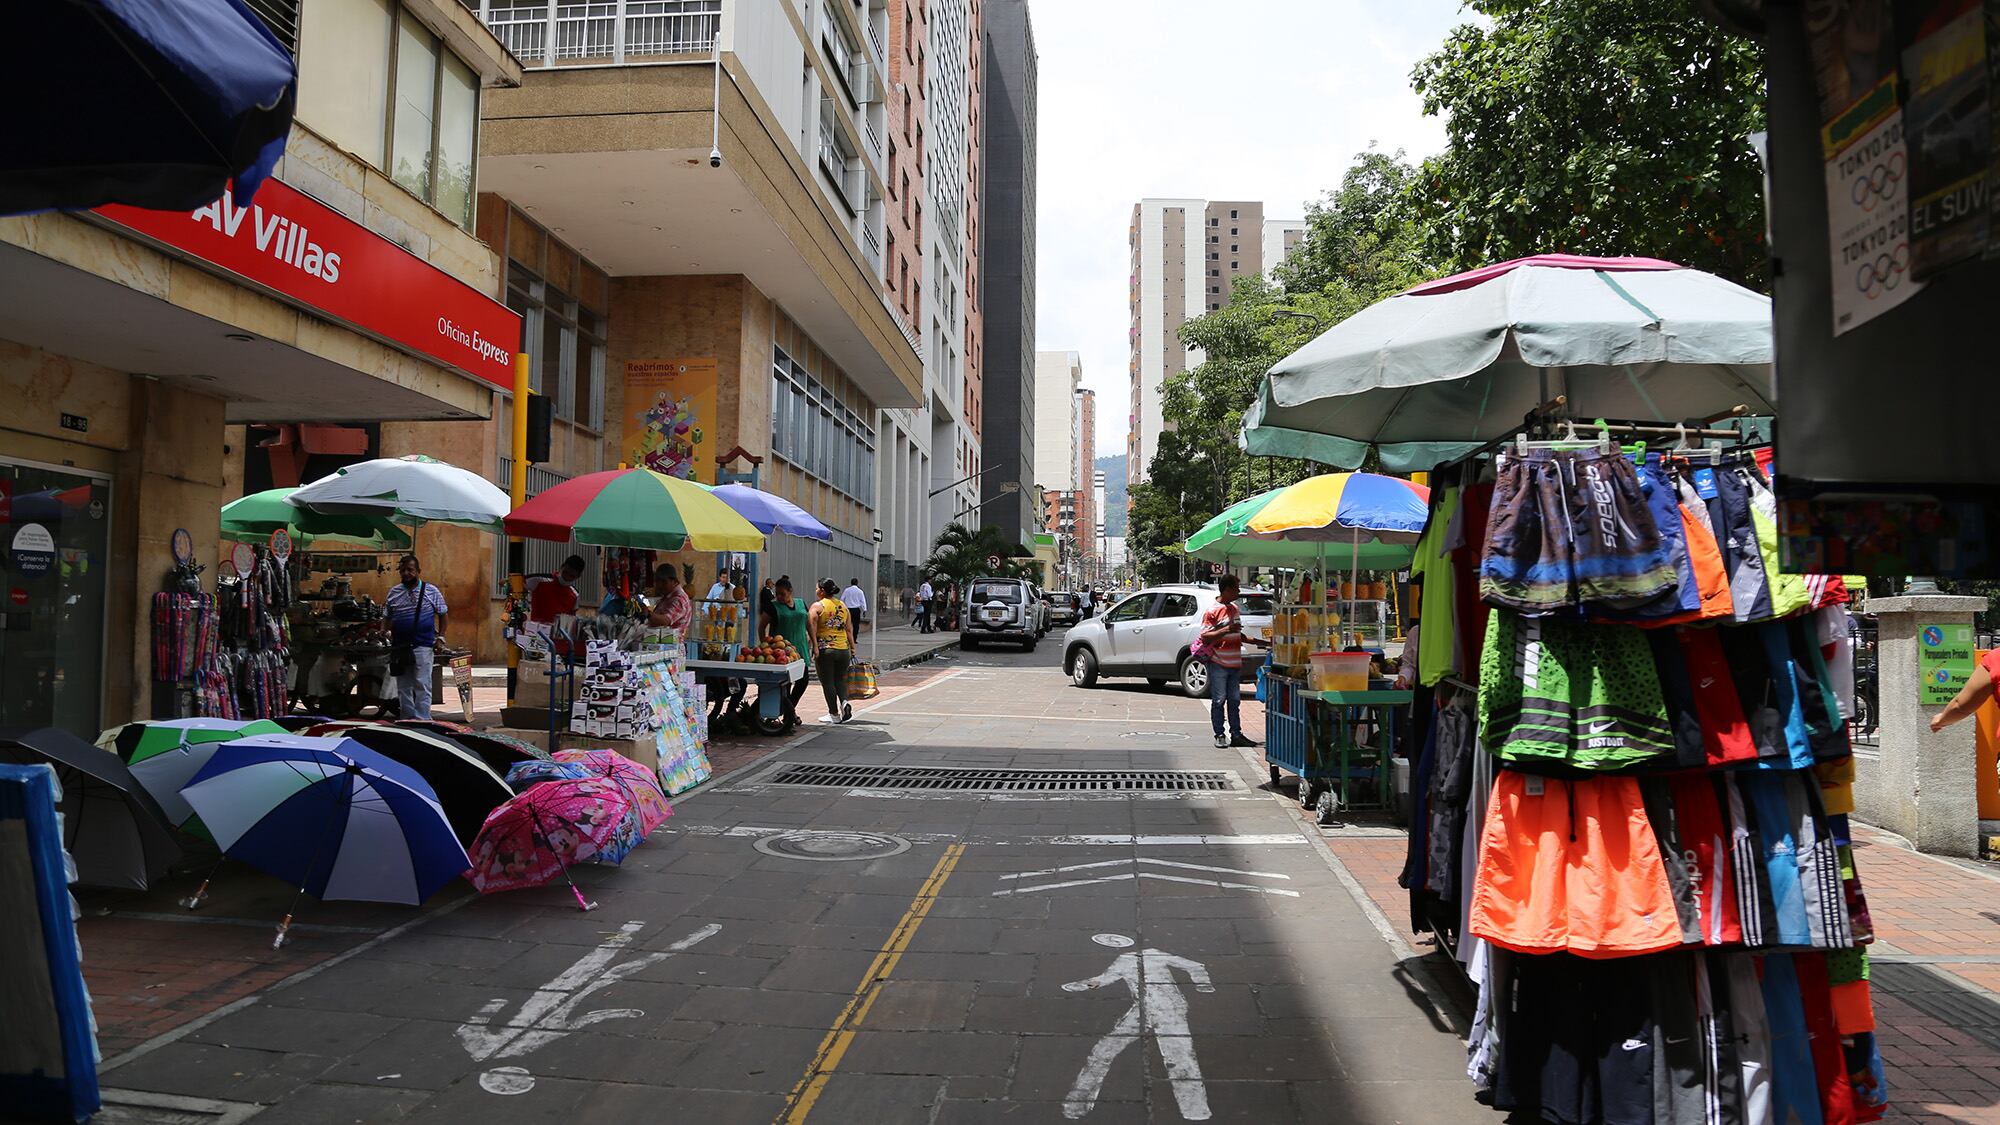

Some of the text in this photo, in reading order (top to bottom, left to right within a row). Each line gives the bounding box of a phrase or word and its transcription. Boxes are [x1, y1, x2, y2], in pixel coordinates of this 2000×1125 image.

[1839, 124, 1905, 180] TOKYO 20
[192, 189, 341, 284] AV Villas
[1842, 226, 1887, 265] TOKYO
[1889, 213, 1906, 241] 20
[1911, 204, 1936, 235] EL
[438, 317, 509, 366] Oficina Express
[627, 362, 675, 372] Reabrimos
[1586, 465, 1618, 548] speedo
[1928, 686, 1963, 695] Talanque
[1952, 676, 1970, 684] Peligr
[1588, 737, 1606, 748] JUST
[1616, 737, 1624, 746] IT
